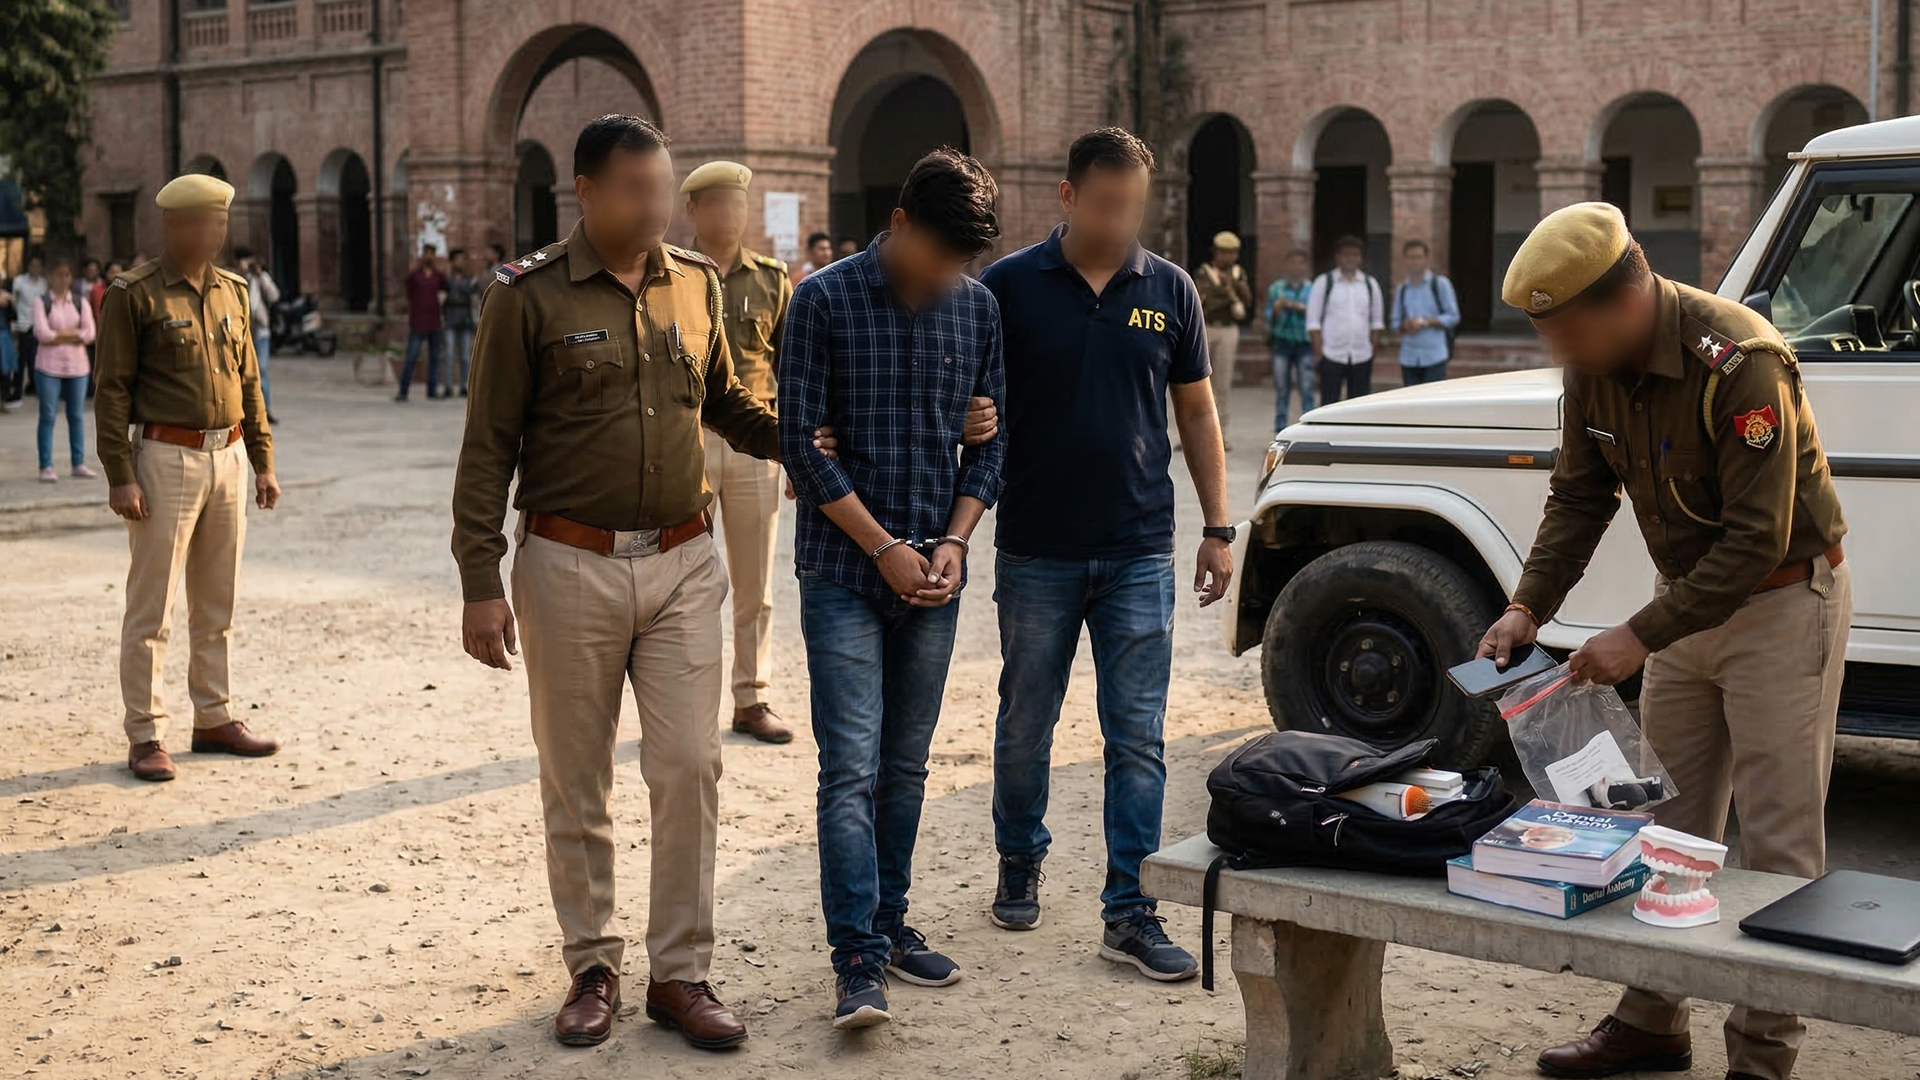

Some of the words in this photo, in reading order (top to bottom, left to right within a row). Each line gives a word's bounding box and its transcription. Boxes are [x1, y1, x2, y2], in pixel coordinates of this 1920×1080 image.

[1128, 308, 1166, 332] ATS
[1537, 814, 1618, 830] Anatomy
[1552, 811, 1612, 823] Dental
